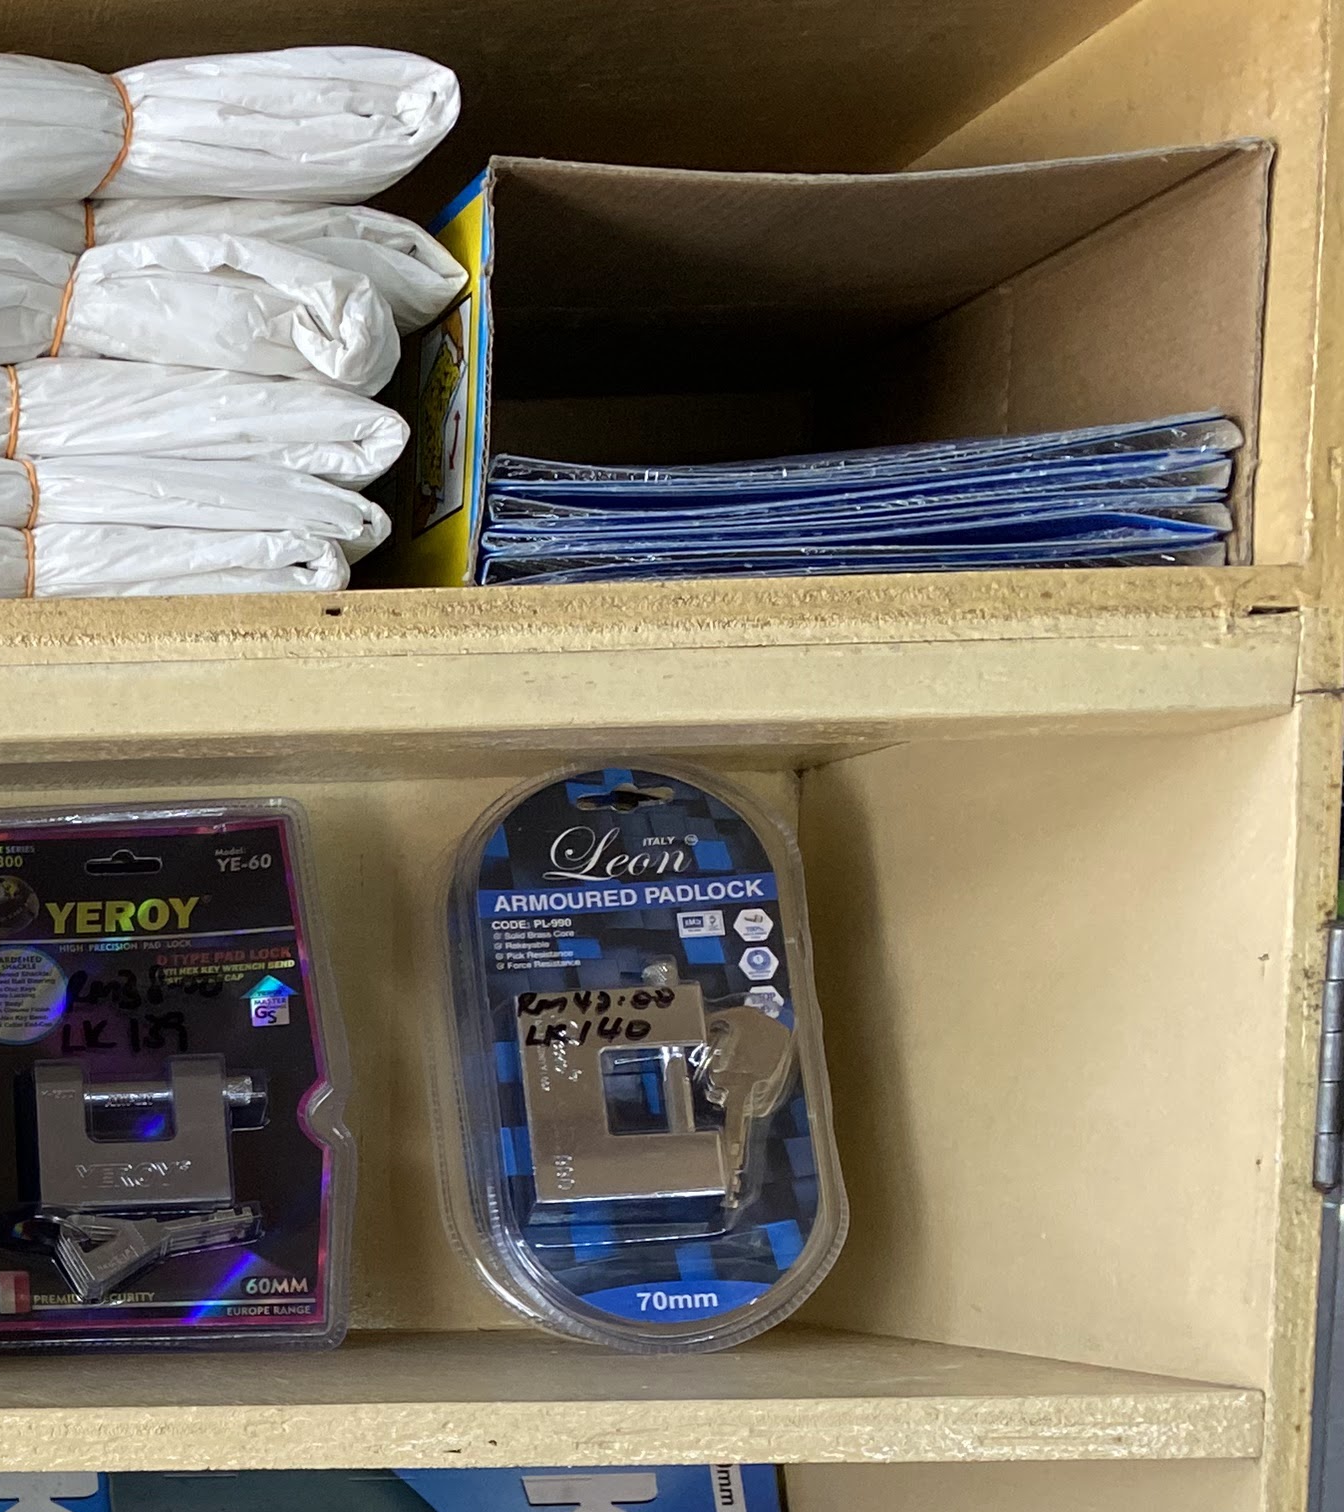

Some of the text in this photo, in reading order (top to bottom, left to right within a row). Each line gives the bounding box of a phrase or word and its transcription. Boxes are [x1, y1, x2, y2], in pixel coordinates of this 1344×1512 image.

[643, 836, 675, 847] ITALY
[542, 825, 692, 881] Leon
[217, 854, 272, 872] YE-60
[493, 880, 764, 913] ARMOURED PADLOCK
[45, 897, 201, 934] YEROY
[492, 918, 572, 930] CODE: PL-990
[505, 932, 524, 940] Solid
[553, 930, 574, 938] Core
[59, 939, 192, 952] HIGH PRECISION PAD LOCK
[173, 948, 292, 965] TYPE PAD LOCK
[526, 950, 573, 958] Resistance
[222, 960, 295, 973] WRENCH BEND
[508, 960, 580, 969] Force Resistance
[245, 1276, 308, 1294] 60MM
[636, 1291, 718, 1310] 70mm
[227, 1305, 311, 1316] EUROPE RANGE
